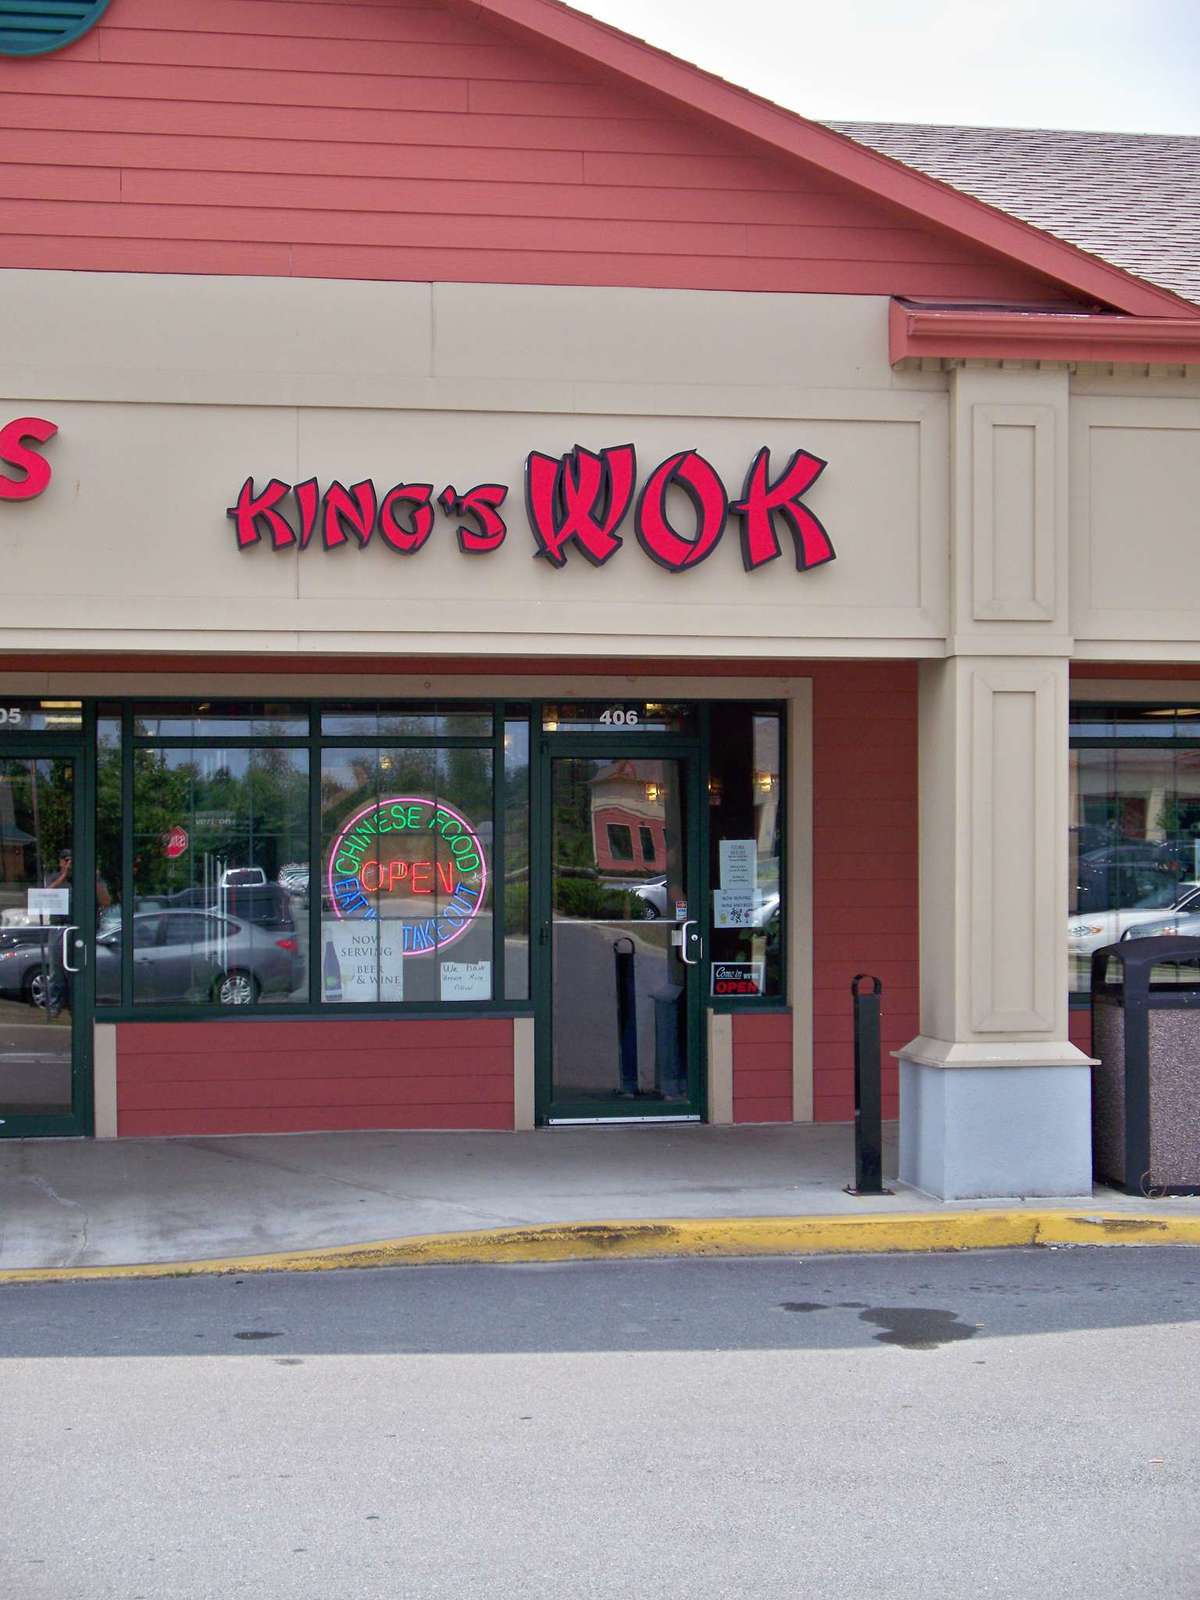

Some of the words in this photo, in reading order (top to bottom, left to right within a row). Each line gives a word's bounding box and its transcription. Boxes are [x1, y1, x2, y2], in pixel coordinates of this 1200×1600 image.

[227, 476, 509, 556] KING'S
[523, 442, 837, 574] WOK
[599, 710, 639, 726] 406
[335, 804, 423, 875] CHINESE
[428, 810, 481, 872] FOOD
[359, 860, 454, 893] OPEN
[334, 877, 369, 915] EAT
[401, 919, 450, 951] TAKE
[442, 880, 480, 928] OUT
[340, 946, 393, 957] SERVING
[357, 964, 385, 974] BEER
[369, 975, 401, 985] WINE
[716, 980, 758, 993] OPEN
